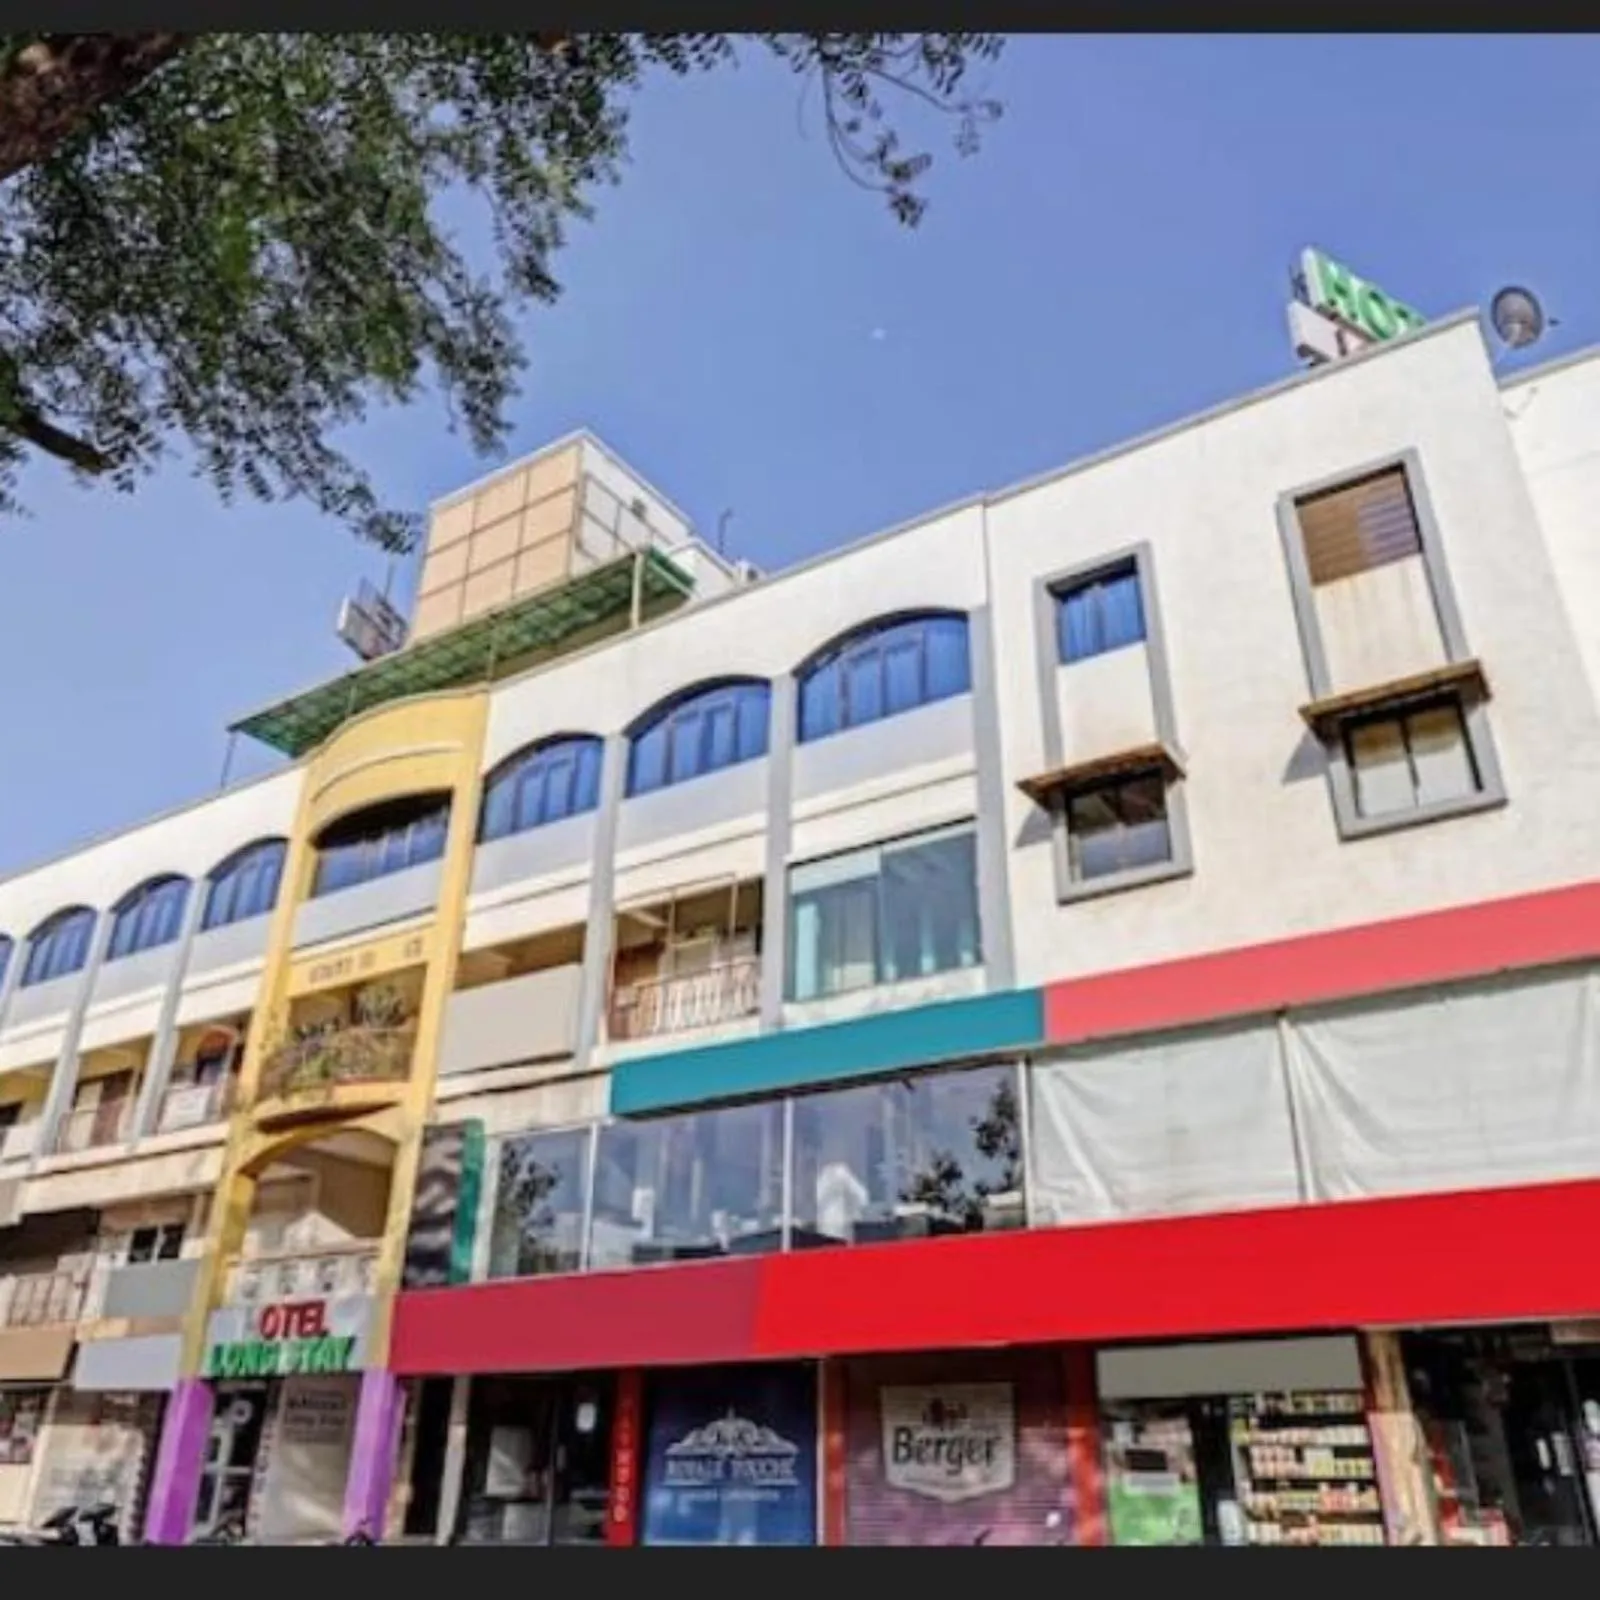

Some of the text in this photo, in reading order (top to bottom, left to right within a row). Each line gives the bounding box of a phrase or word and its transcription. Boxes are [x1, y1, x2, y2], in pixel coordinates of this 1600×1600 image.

[258, 1300, 330, 1340] OTEL
[205, 1335, 356, 1377] LONG STAY
[893, 1426, 1003, 1477] Berger
